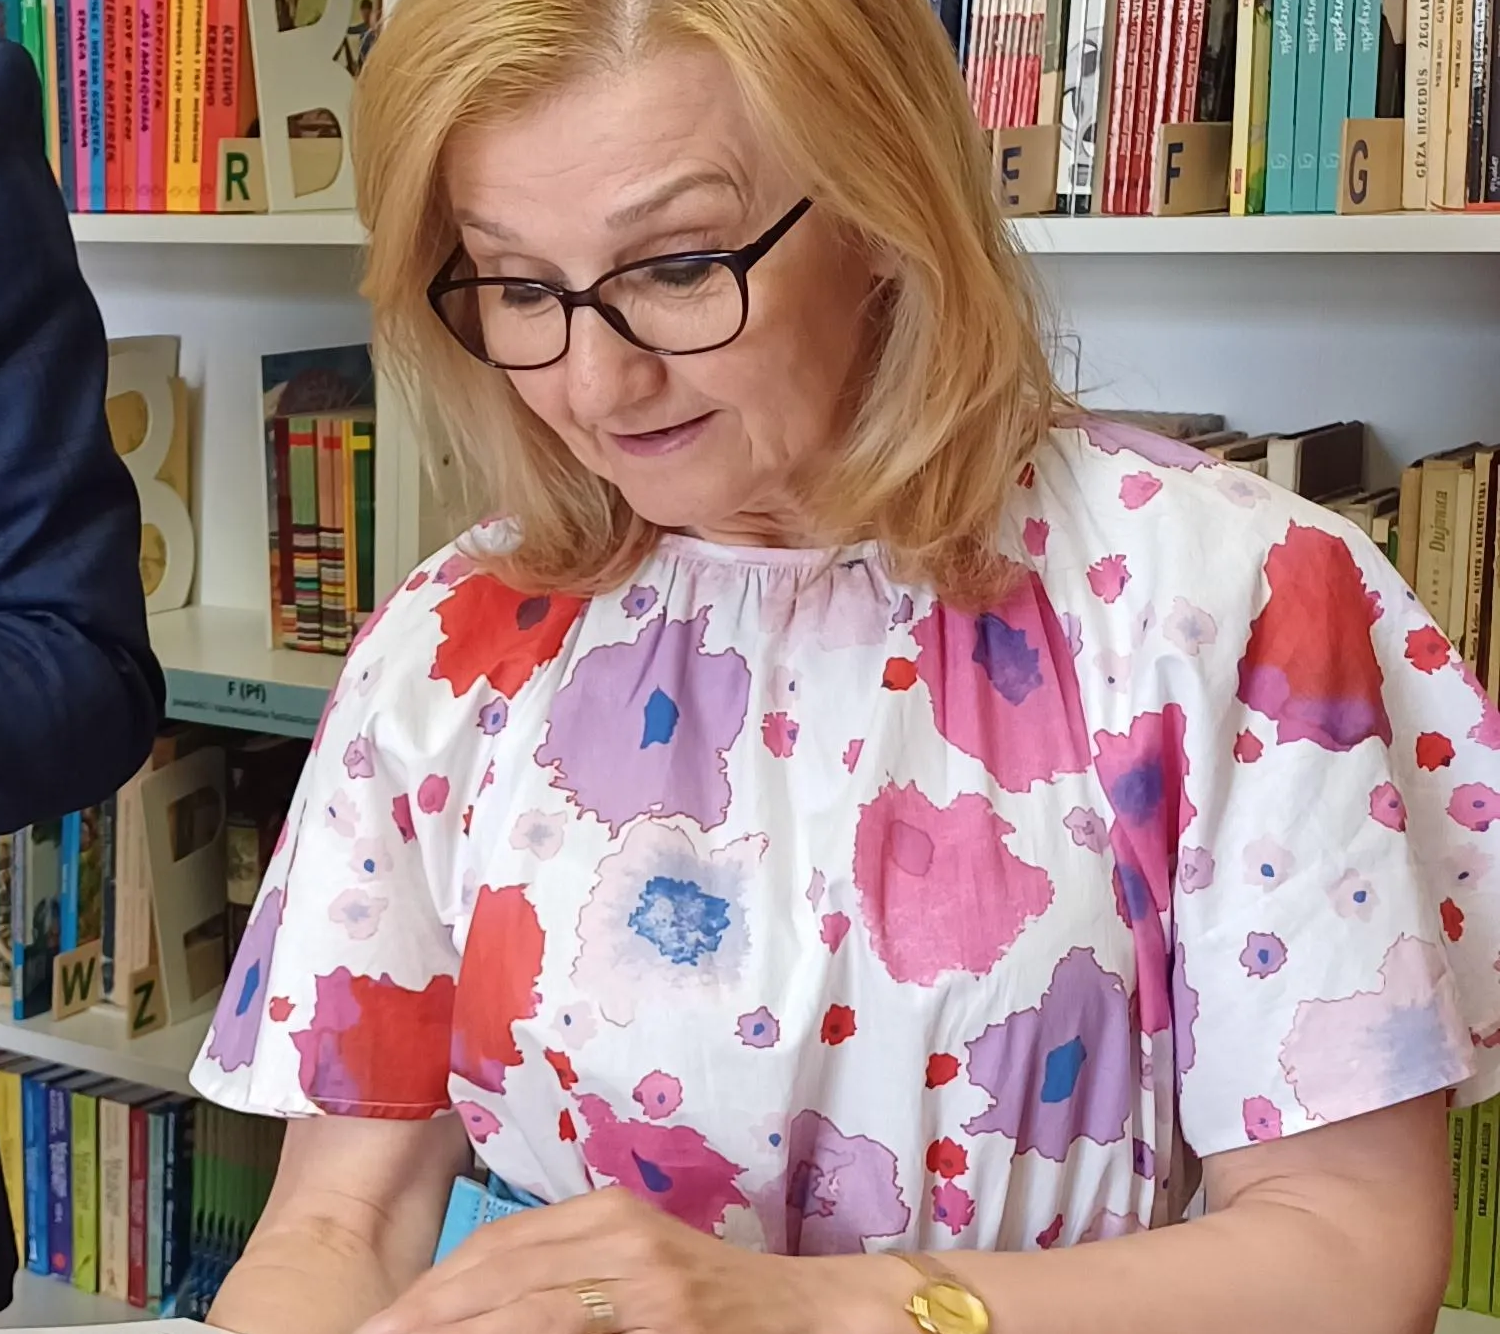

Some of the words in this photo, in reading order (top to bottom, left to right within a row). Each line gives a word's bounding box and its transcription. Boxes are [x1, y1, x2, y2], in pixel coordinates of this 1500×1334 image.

[1417, 68, 1429, 135] HEGEDÜS
[224, 151, 250, 202] R
[1166, 141, 1185, 197] F
[1347, 138, 1370, 205] G
[1415, 140, 1428, 178] GÉZA
[60, 955, 97, 1003] W
[131, 979, 157, 1033] Z
